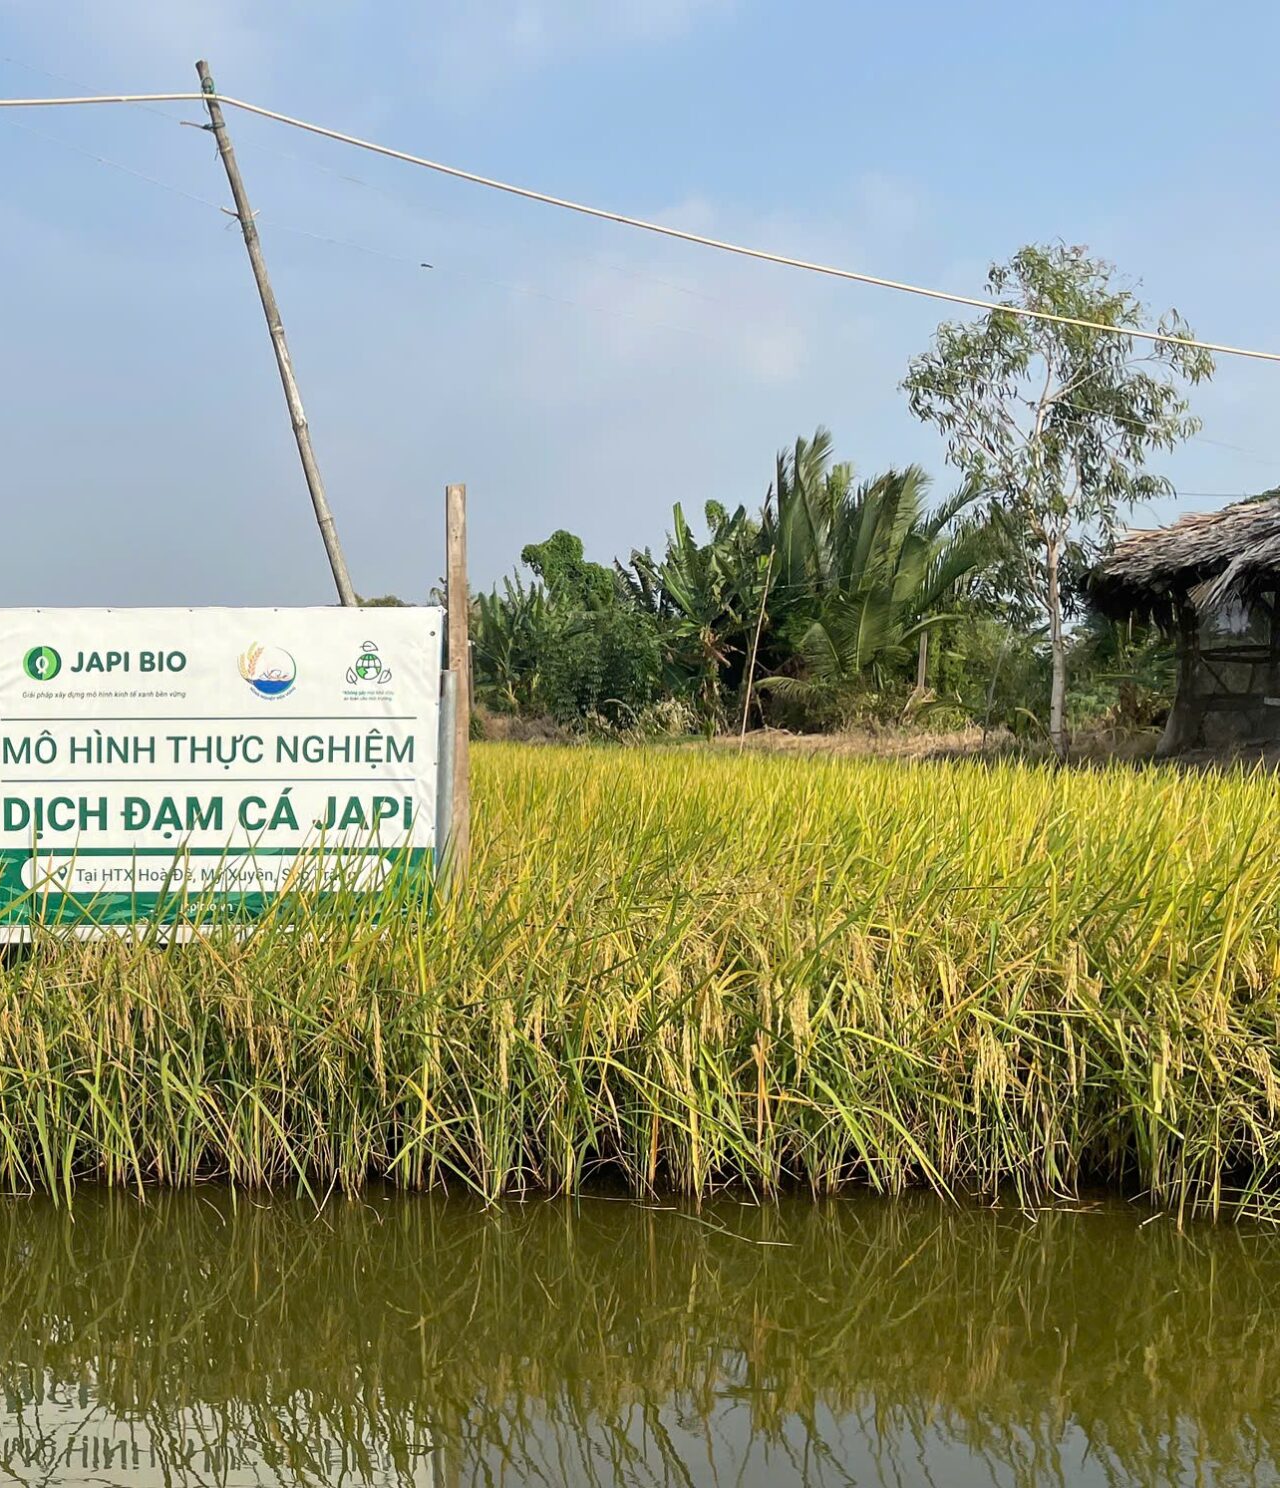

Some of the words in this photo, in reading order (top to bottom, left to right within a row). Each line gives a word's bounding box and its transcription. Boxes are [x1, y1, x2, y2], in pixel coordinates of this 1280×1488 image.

[70, 651, 130, 673] JAPI
[139, 650, 187, 673] BIO
[36, 690, 54, 700] pháp
[55, 690, 66, 700] xây
[67, 689, 85, 700] dựng
[86, 690, 98, 698] mô
[114, 690, 129, 698] kinh
[138, 690, 154, 698] xanh
[2, 729, 58, 765] MÔ
[70, 728, 155, 764] HÌNH
[166, 734, 264, 770] THỰC
[276, 728, 415, 769] NGHIỆM
[3, 796, 108, 840] DỊCH
[120, 796, 223, 839] ĐẠM
[238, 787, 300, 831] CÁ
[312, 796, 413, 831] JAPI
[75, 868, 98, 885] Tại
[102, 868, 133, 881] HTX
[138, 867, 169, 881] Hoà
